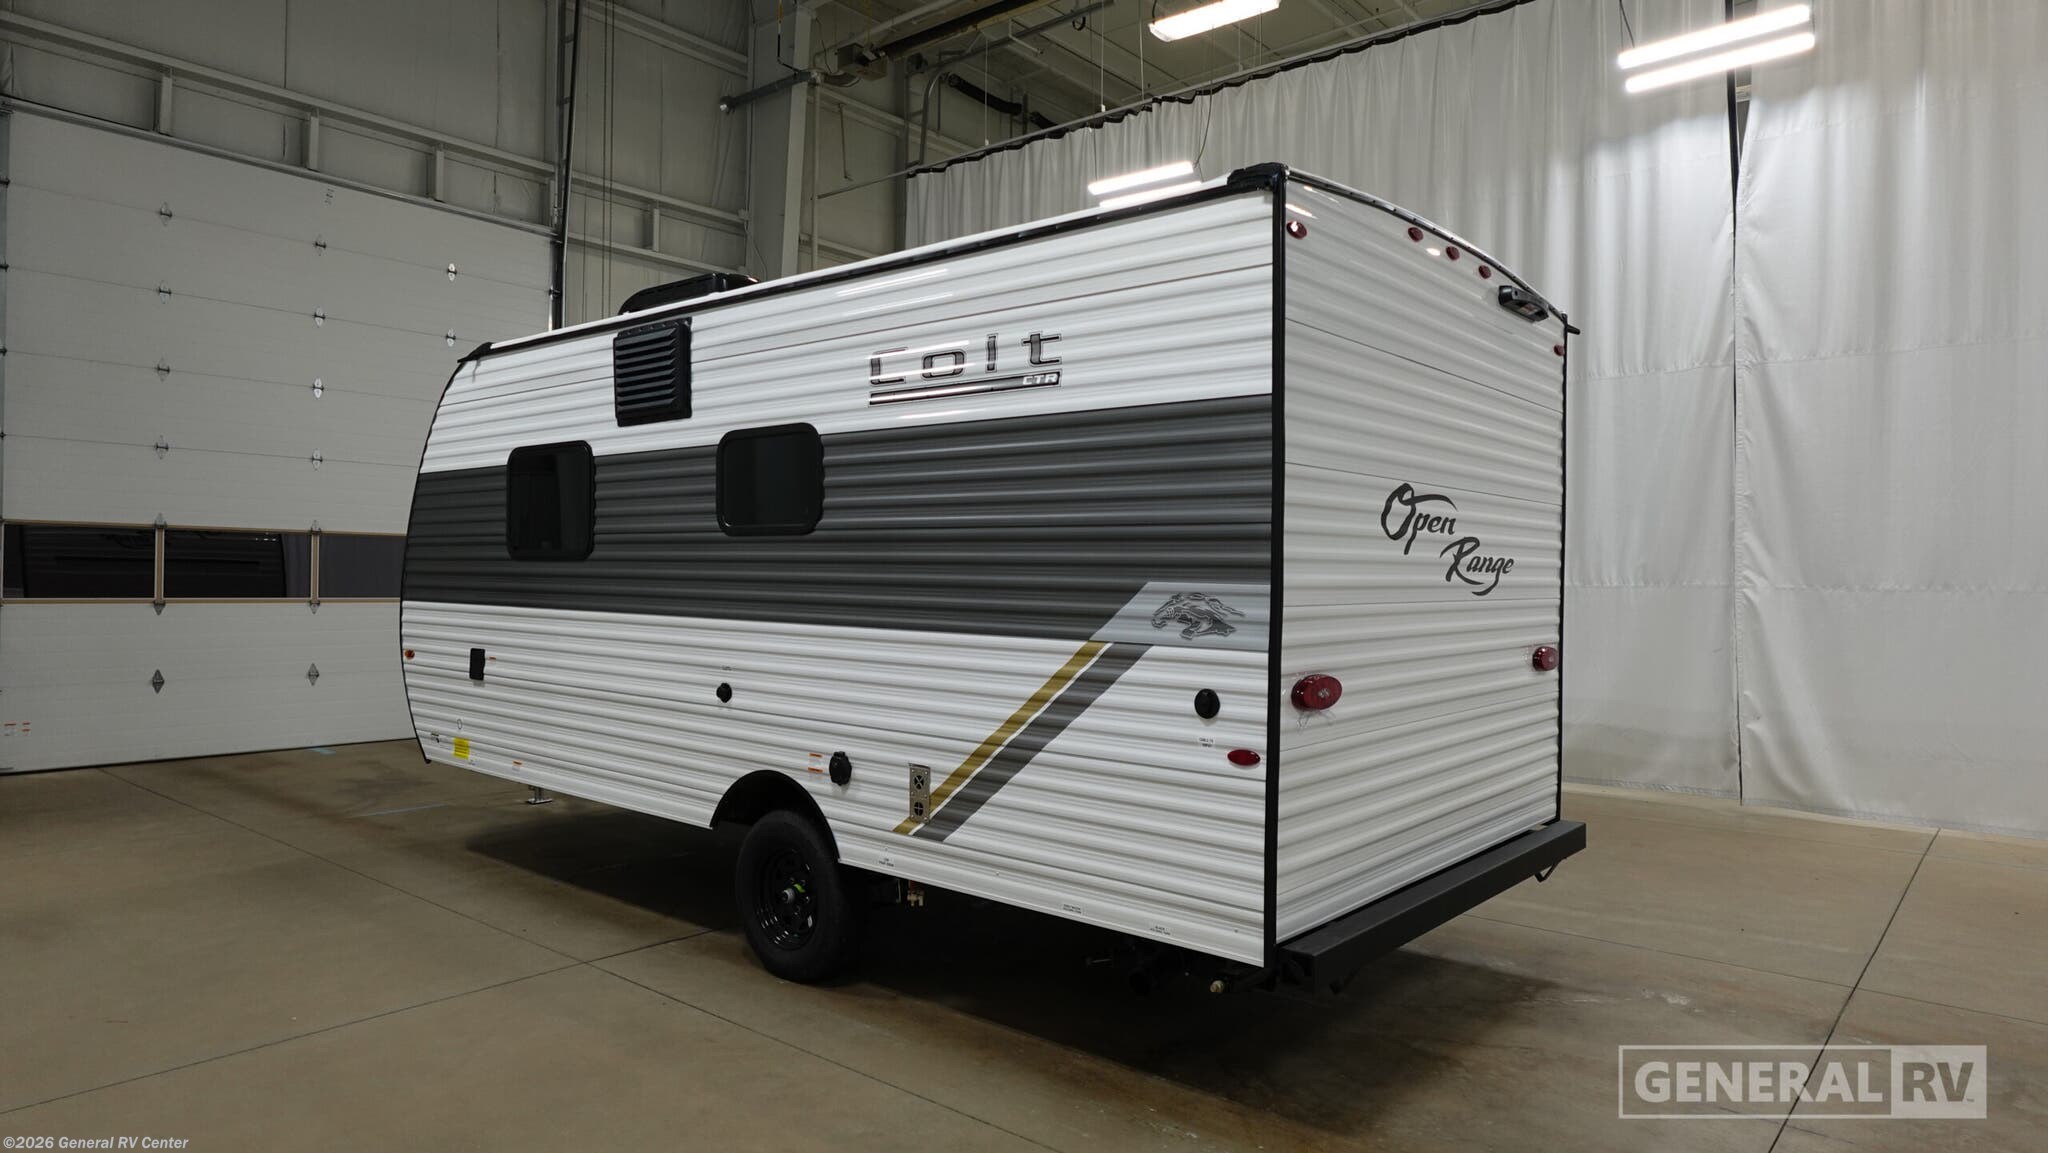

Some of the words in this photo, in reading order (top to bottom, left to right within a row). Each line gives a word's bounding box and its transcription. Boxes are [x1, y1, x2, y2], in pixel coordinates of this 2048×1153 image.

[869, 332, 1062, 386] Colt
[1022, 372, 1059, 386] CTR
[1380, 482, 1459, 556] Open
[1439, 536, 1515, 597] Range
